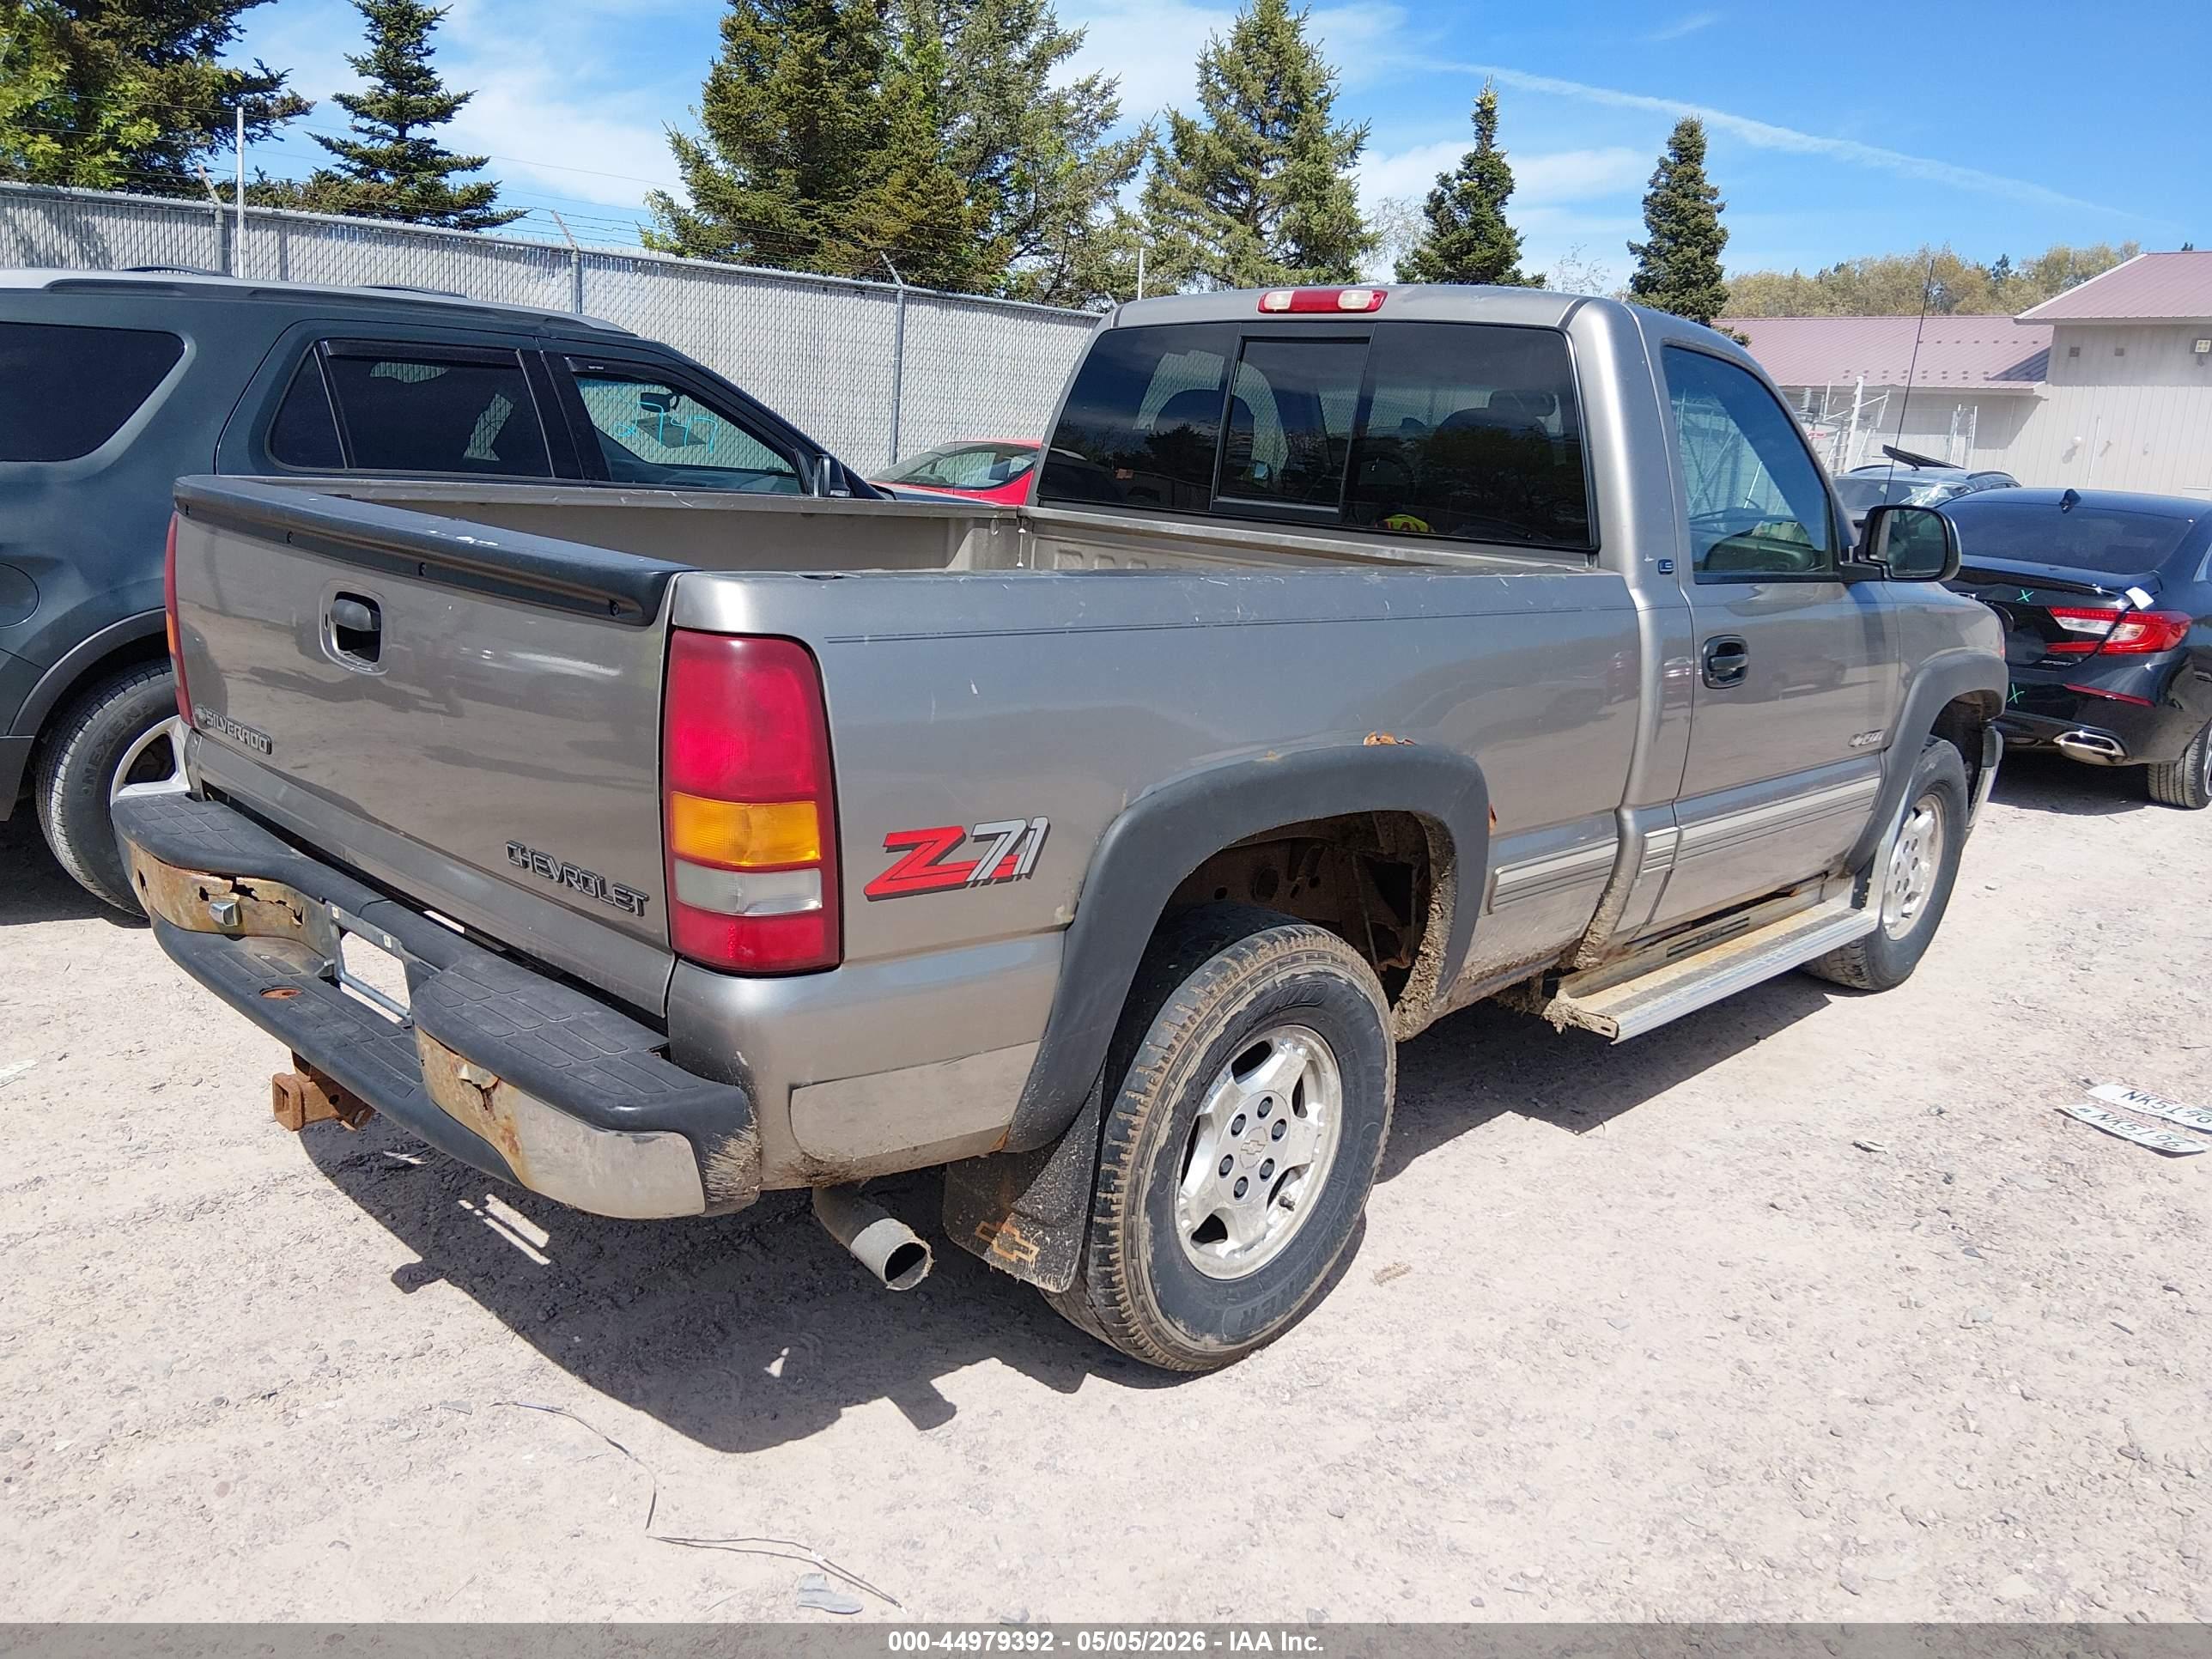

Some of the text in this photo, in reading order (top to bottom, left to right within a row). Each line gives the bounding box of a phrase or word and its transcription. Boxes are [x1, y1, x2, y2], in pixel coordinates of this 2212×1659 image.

[206, 709, 270, 754] SILVERADO
[505, 839, 651, 917] CHEVROLET
[863, 816, 1051, 902] Z71
[2092, 1113, 2185, 1150] NK5196
